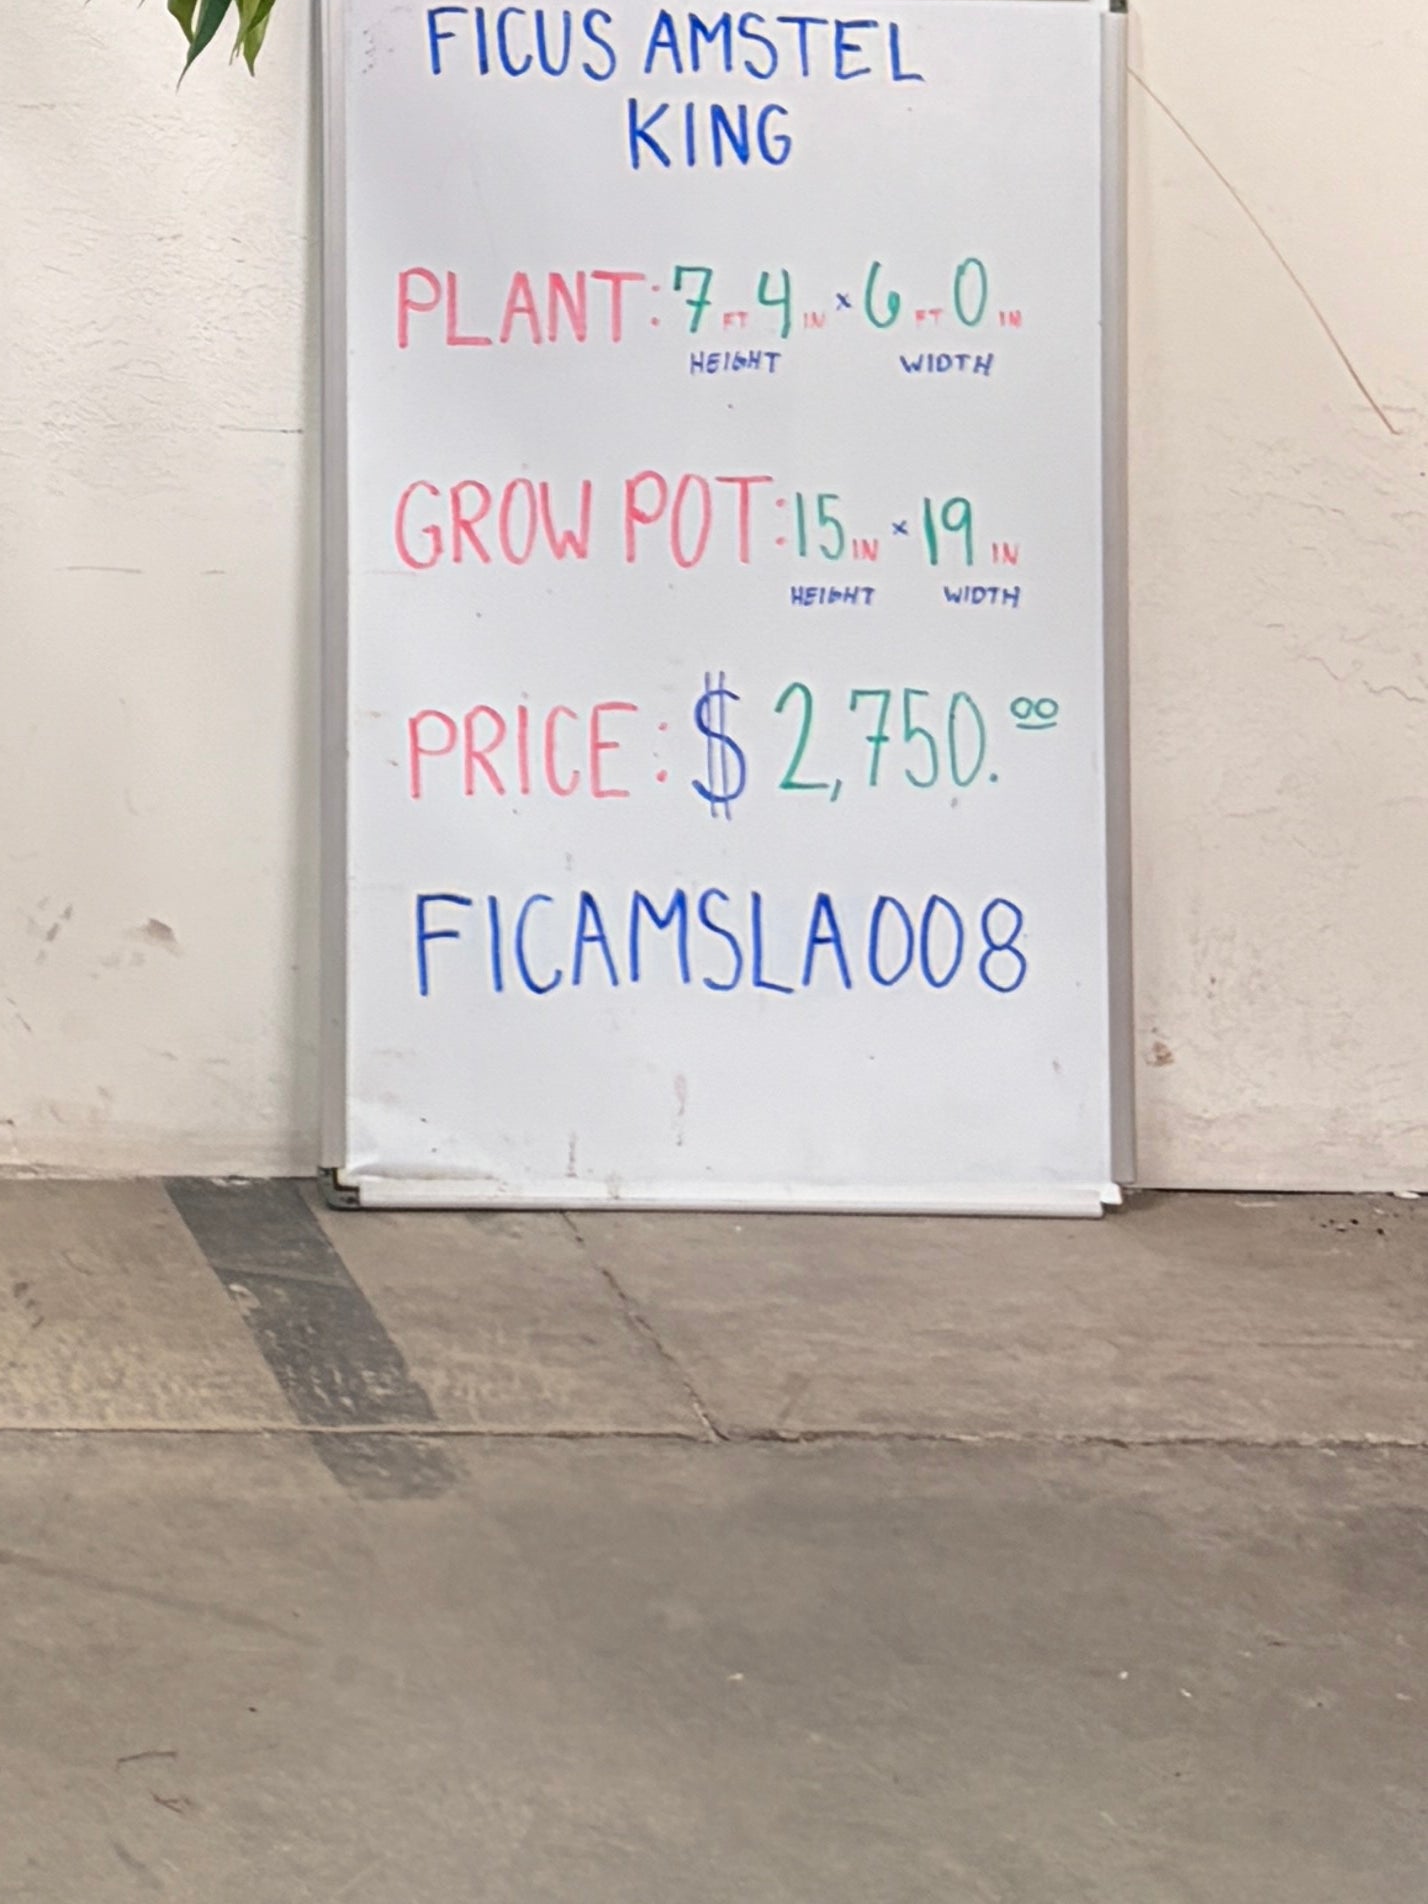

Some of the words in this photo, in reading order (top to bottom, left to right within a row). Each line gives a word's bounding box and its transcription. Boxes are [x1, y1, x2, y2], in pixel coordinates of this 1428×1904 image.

[427, 6, 618, 82] FICUS
[643, 10, 924, 82] AMSTEL
[628, 98, 793, 170] KING
[397, 267, 661, 350] PLANT:
[689, 350, 782, 375] HEIGHT
[899, 352, 994, 377] WIDTH
[395, 477, 593, 570] GROW
[624, 470, 788, 569] POT:
[795, 491, 846, 561] 15
[923, 495, 974, 566] 19
[790, 585, 876, 607] HEIGHT
[943, 585, 1021, 608] WIDTH
[408, 702, 669, 800] PRICE:
[415, 888, 1029, 997] FICAMSLA008
